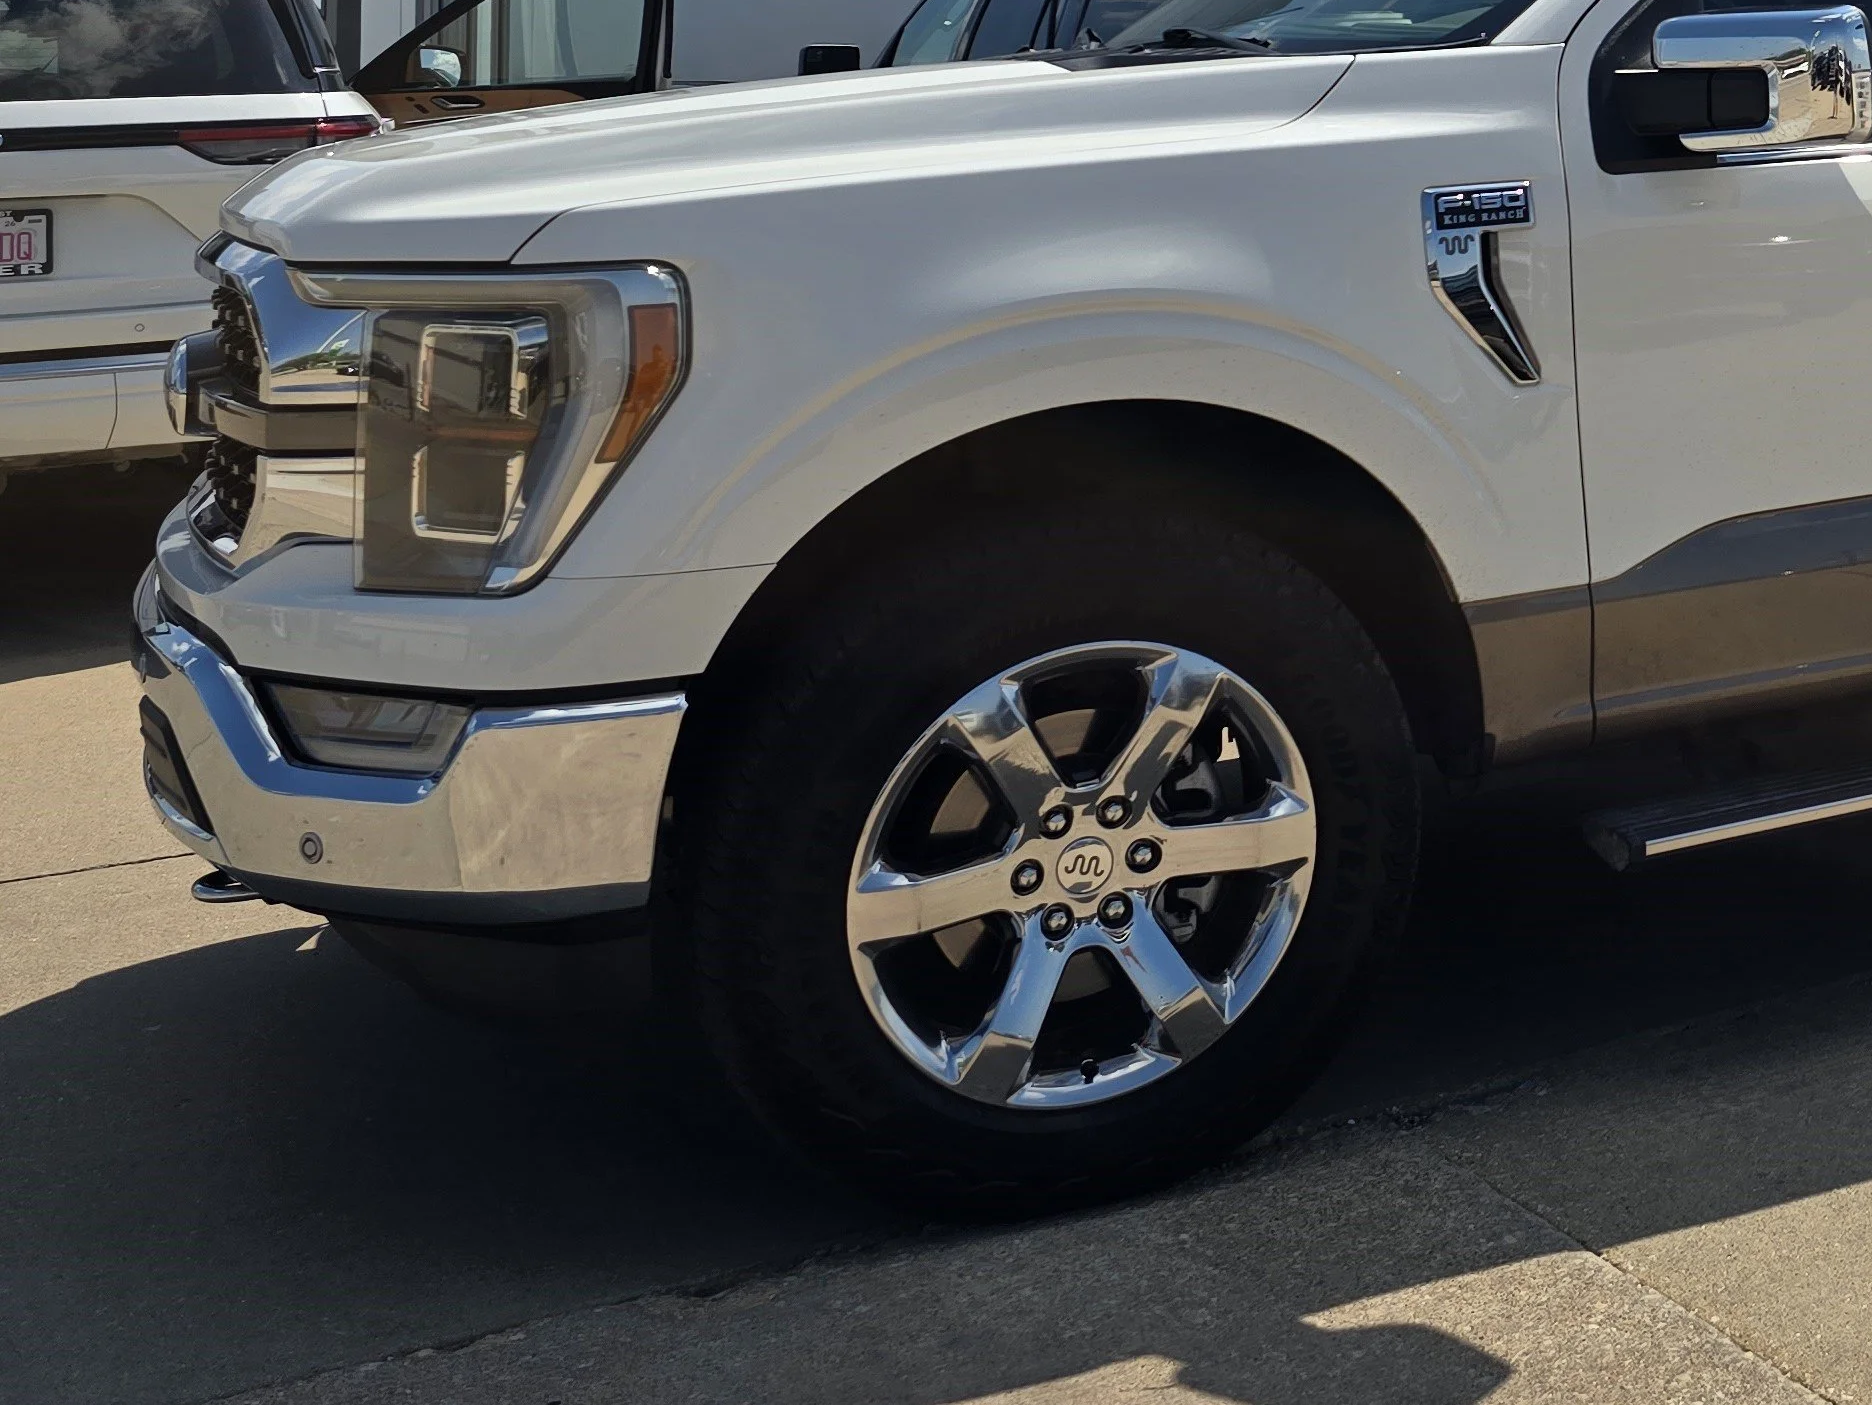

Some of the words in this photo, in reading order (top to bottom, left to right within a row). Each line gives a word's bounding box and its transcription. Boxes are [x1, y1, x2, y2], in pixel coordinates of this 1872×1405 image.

[1437, 188, 1526, 213] F-150
[1443, 213, 1476, 225] KING
[1481, 210, 1525, 222] RANCH
